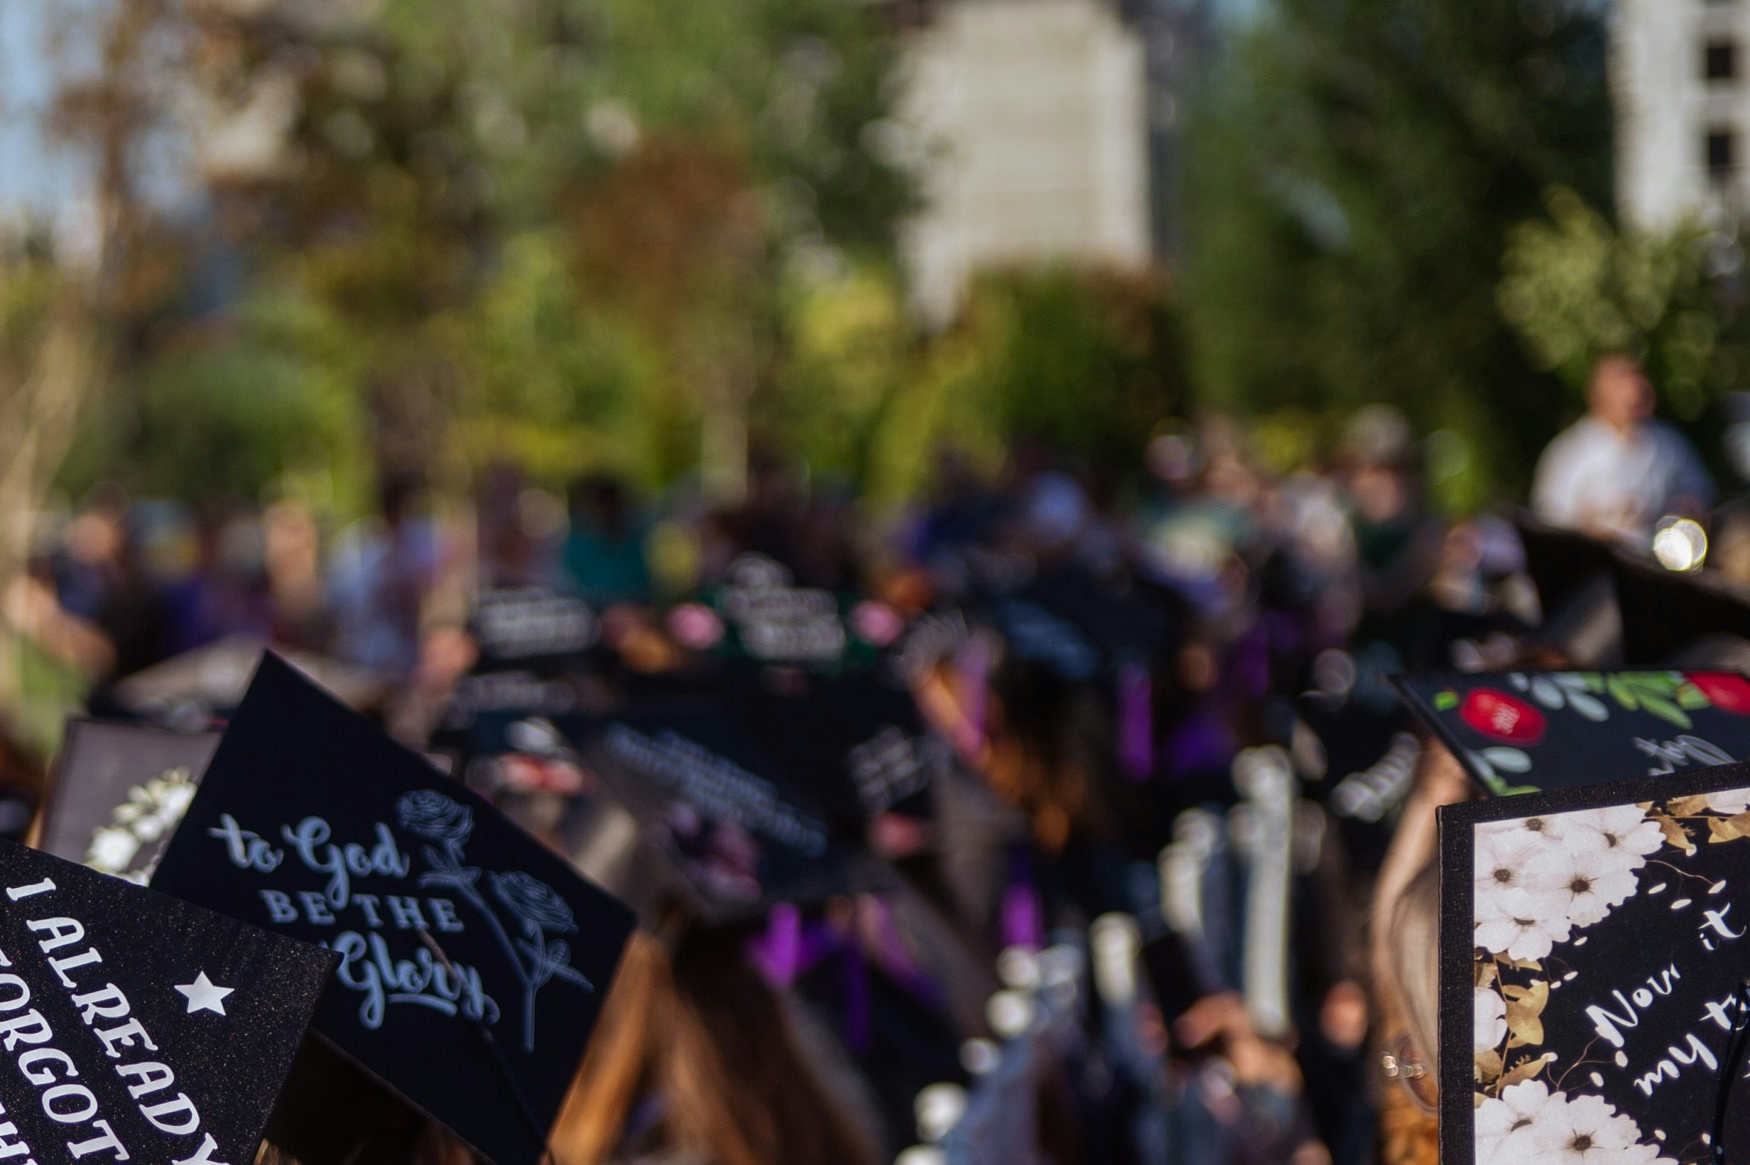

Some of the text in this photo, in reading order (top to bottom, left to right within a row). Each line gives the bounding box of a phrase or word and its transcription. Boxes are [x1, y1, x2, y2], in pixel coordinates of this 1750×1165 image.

[5, 877, 57, 902] I
[209, 812, 410, 908] to God
[261, 889, 464, 931] BE THE
[328, 930, 500, 1030] Glory
[1634, 1033, 1718, 1095] my
